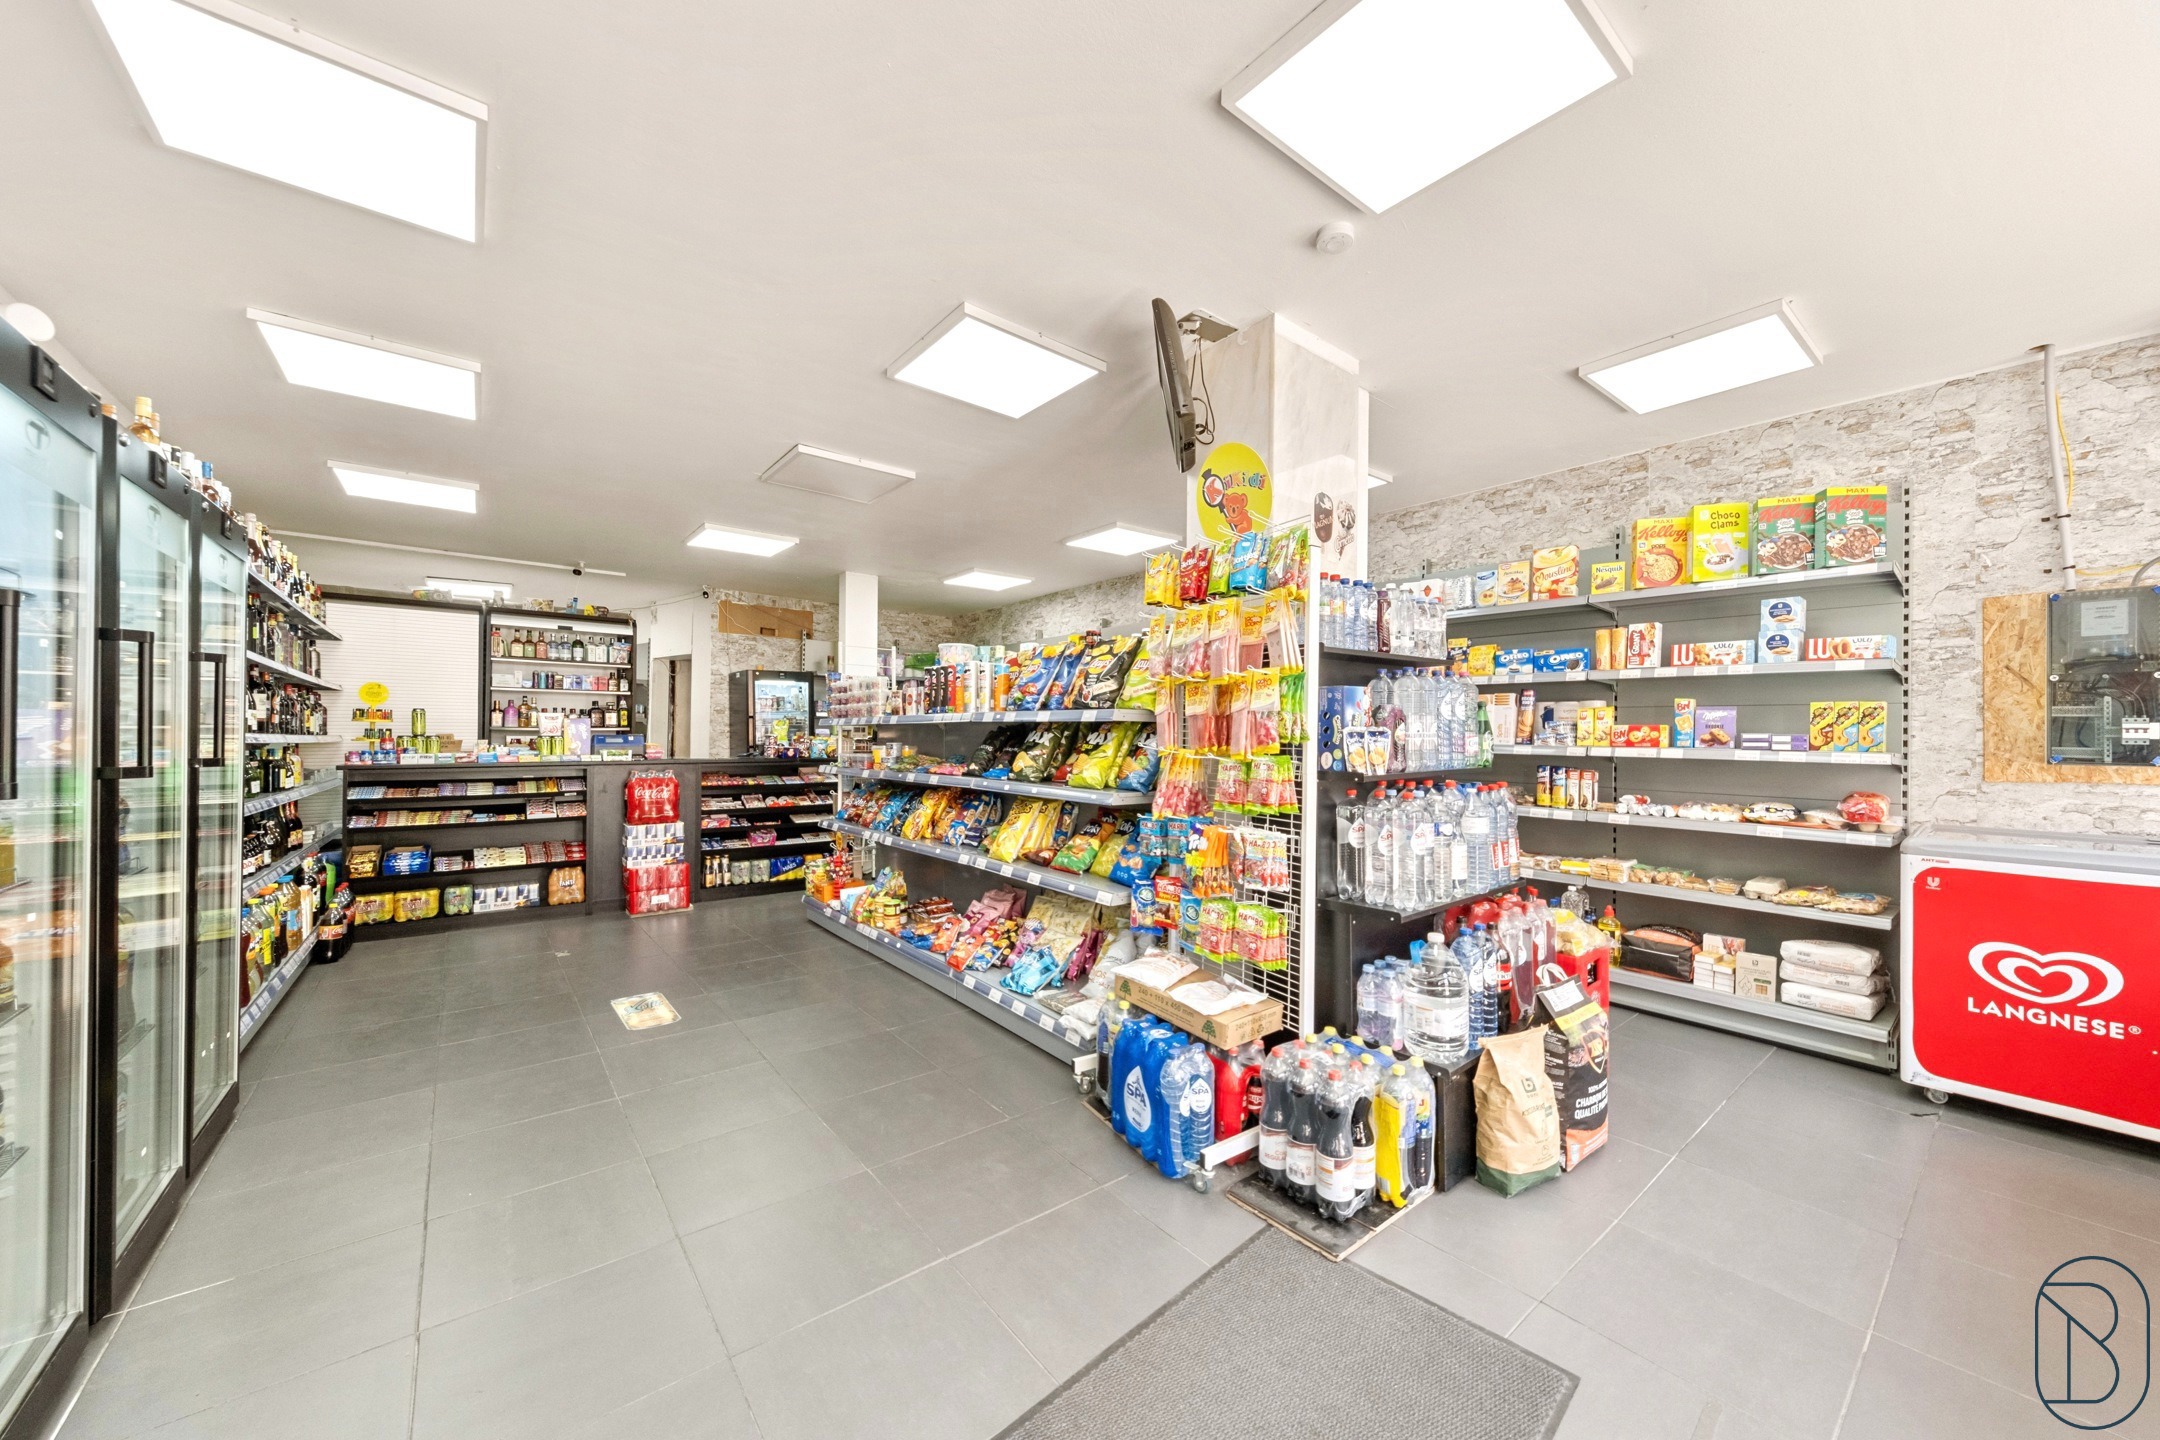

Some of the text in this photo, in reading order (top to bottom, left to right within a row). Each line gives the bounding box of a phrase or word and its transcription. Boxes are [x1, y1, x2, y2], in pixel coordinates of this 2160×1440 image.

[1710, 510, 1740, 520] Choco
[1710, 520, 1740, 530] Clams
[1596, 565, 1623, 574] Nesquik
[1713, 642, 1734, 650] LULU
[1500, 652, 1529, 663] OREO
[1548, 651, 1584, 664] OREO
[1673, 643, 1695, 666] LU
[1613, 730, 1627, 740] BN
[1126, 1082, 1147, 1108] SPA
